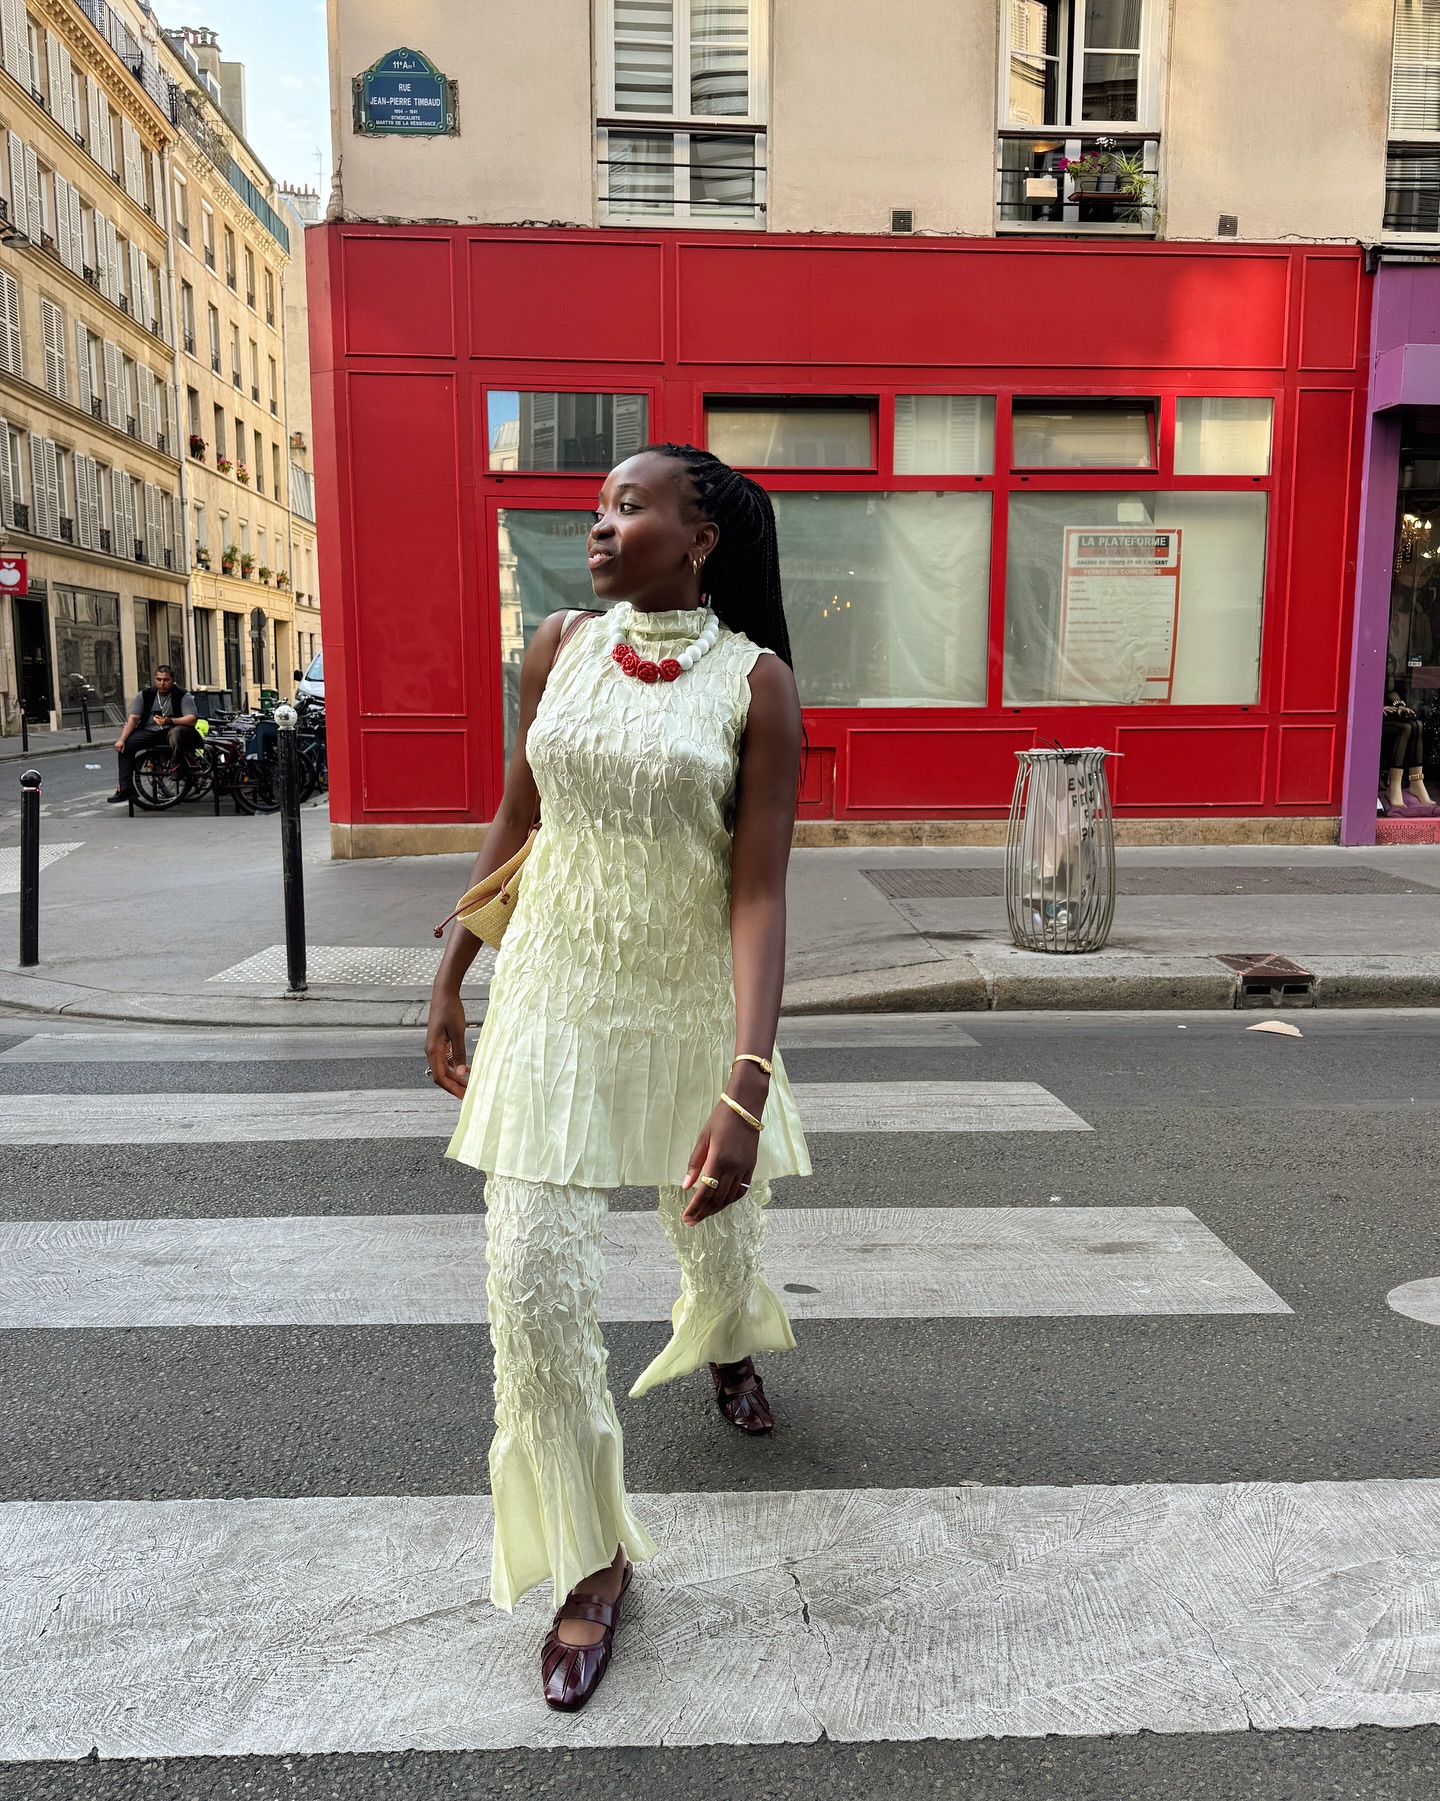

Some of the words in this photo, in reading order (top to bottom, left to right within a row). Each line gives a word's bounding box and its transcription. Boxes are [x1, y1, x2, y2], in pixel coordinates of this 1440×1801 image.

[398, 83, 411, 92] RUE
[369, 97, 412, 106] JEAN-PIERRE
[413, 97, 441, 107] TIMBAUD
[1081, 536, 1095, 546] LA
[1098, 536, 1167, 547] PLATEFORME
